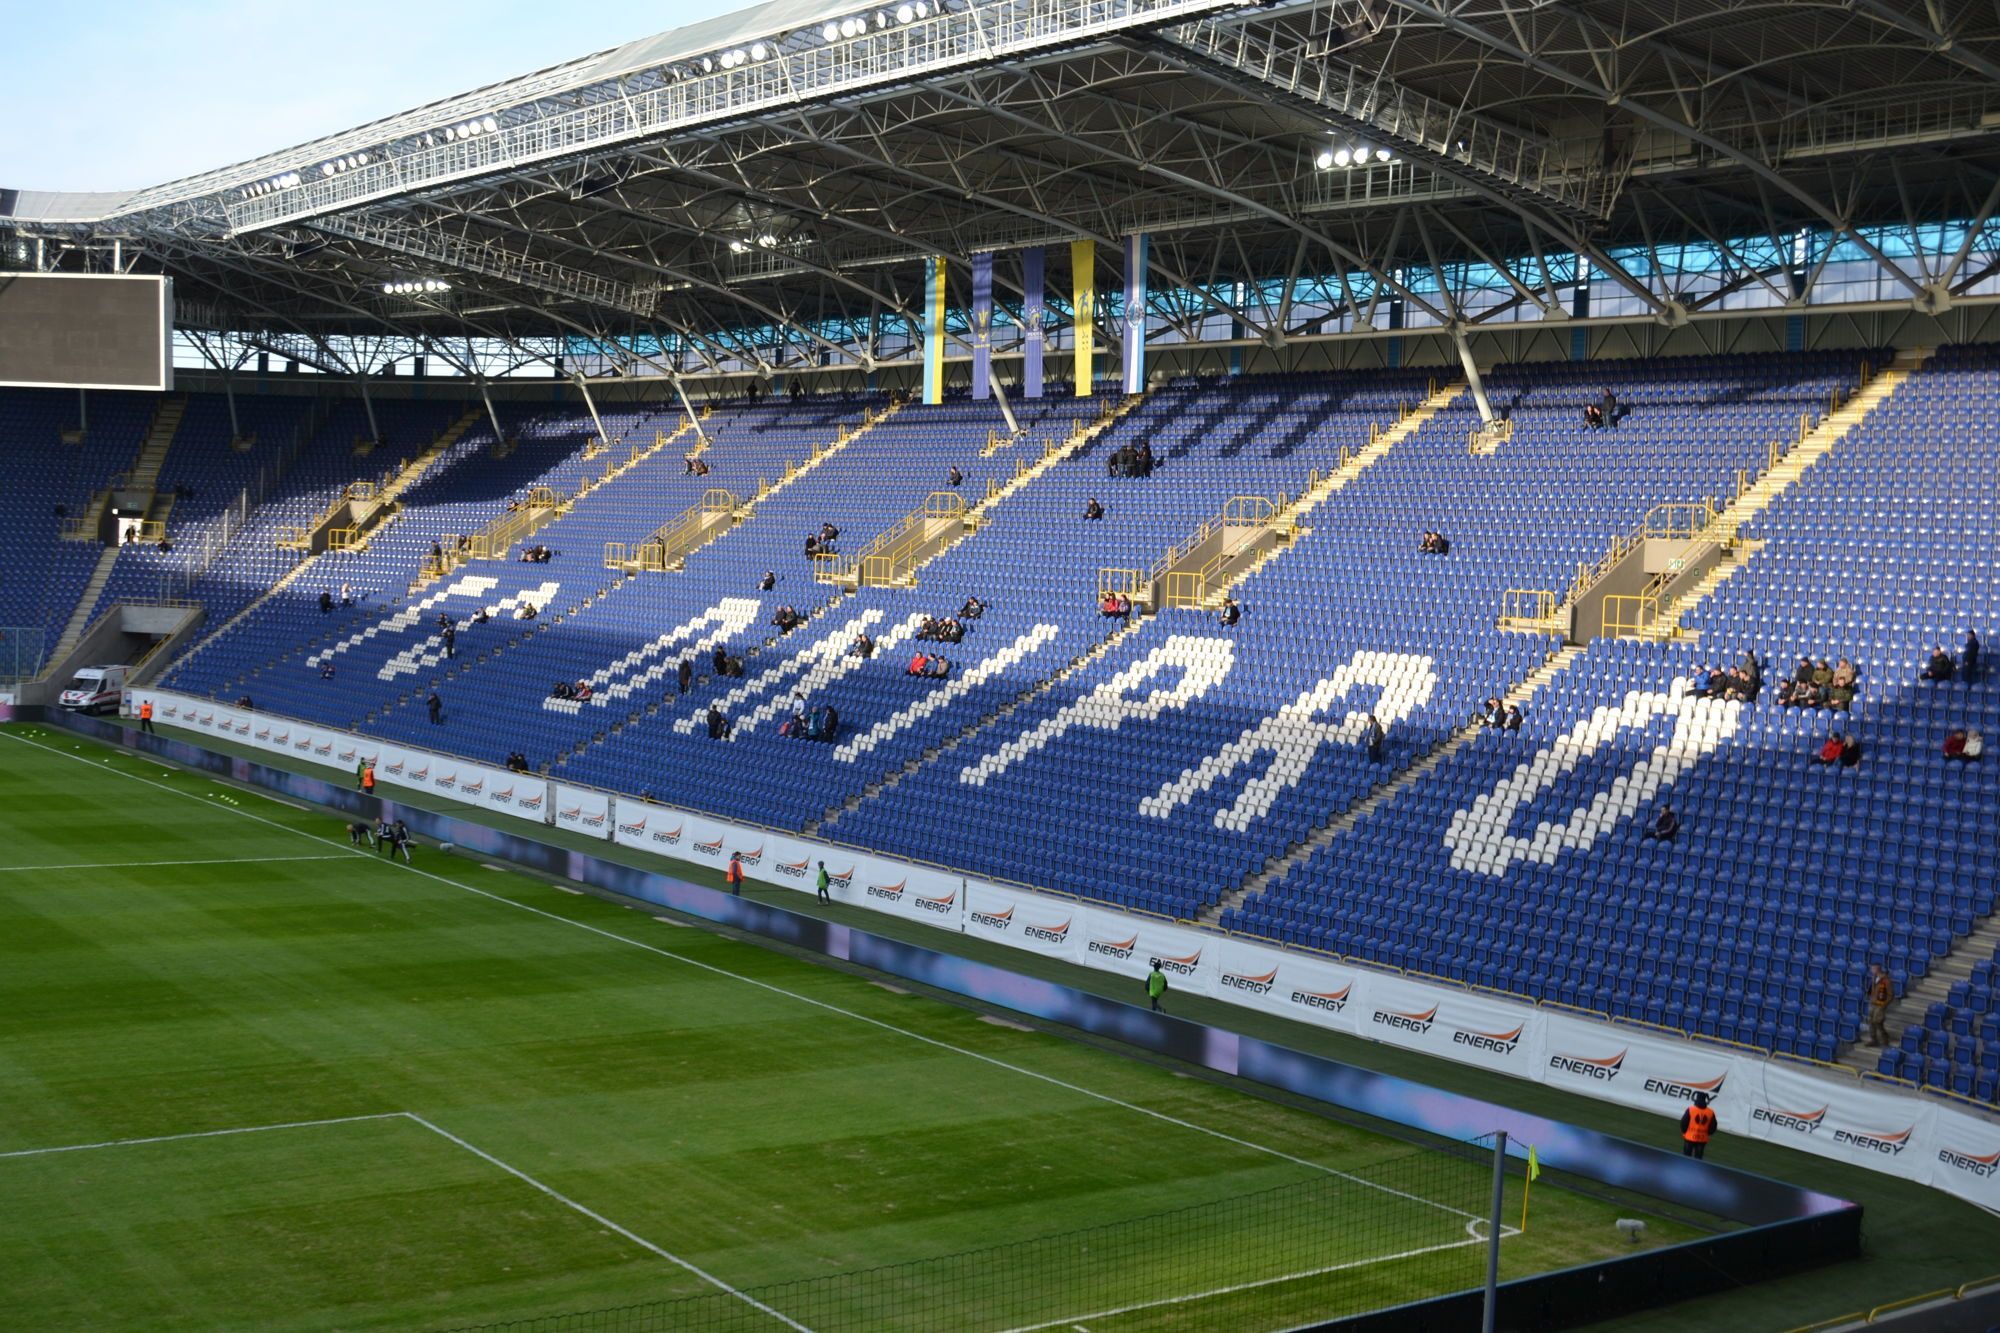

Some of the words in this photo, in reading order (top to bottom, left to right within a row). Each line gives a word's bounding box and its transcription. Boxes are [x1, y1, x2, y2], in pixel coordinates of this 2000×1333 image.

[542, 597, 1742, 877] DNIPRO
[559, 812, 578, 822] ENERGY
[582, 818, 602, 828] ENERGY
[618, 824, 644, 837] ENERGY
[653, 832, 680, 846] ENERGY
[692, 843, 721, 856] ENERGY
[740, 856, 760, 866] ERGY
[776, 864, 806, 878] ENERGY
[829, 878, 851, 889] ERGY
[867, 886, 902, 902] ENERGY
[915, 898, 952, 914] ENERGY
[971, 912, 1010, 930] ENERGY
[1025, 926, 1066, 944] ENERGY
[1088, 942, 1132, 960] ENERGY
[1222, 974, 1272, 995] ENERGY
[1292, 992, 1346, 1013] ENERGY
[1373, 1011, 1432, 1034] ENERGY
[1454, 1031, 1516, 1055] ENERGY
[1550, 1056, 1618, 1082] ENERGY
[1753, 1108, 1820, 1134] ENERGY
[1834, 1130, 1904, 1156] ENERGY
[1938, 1150, 1998, 1178] ENERGY
